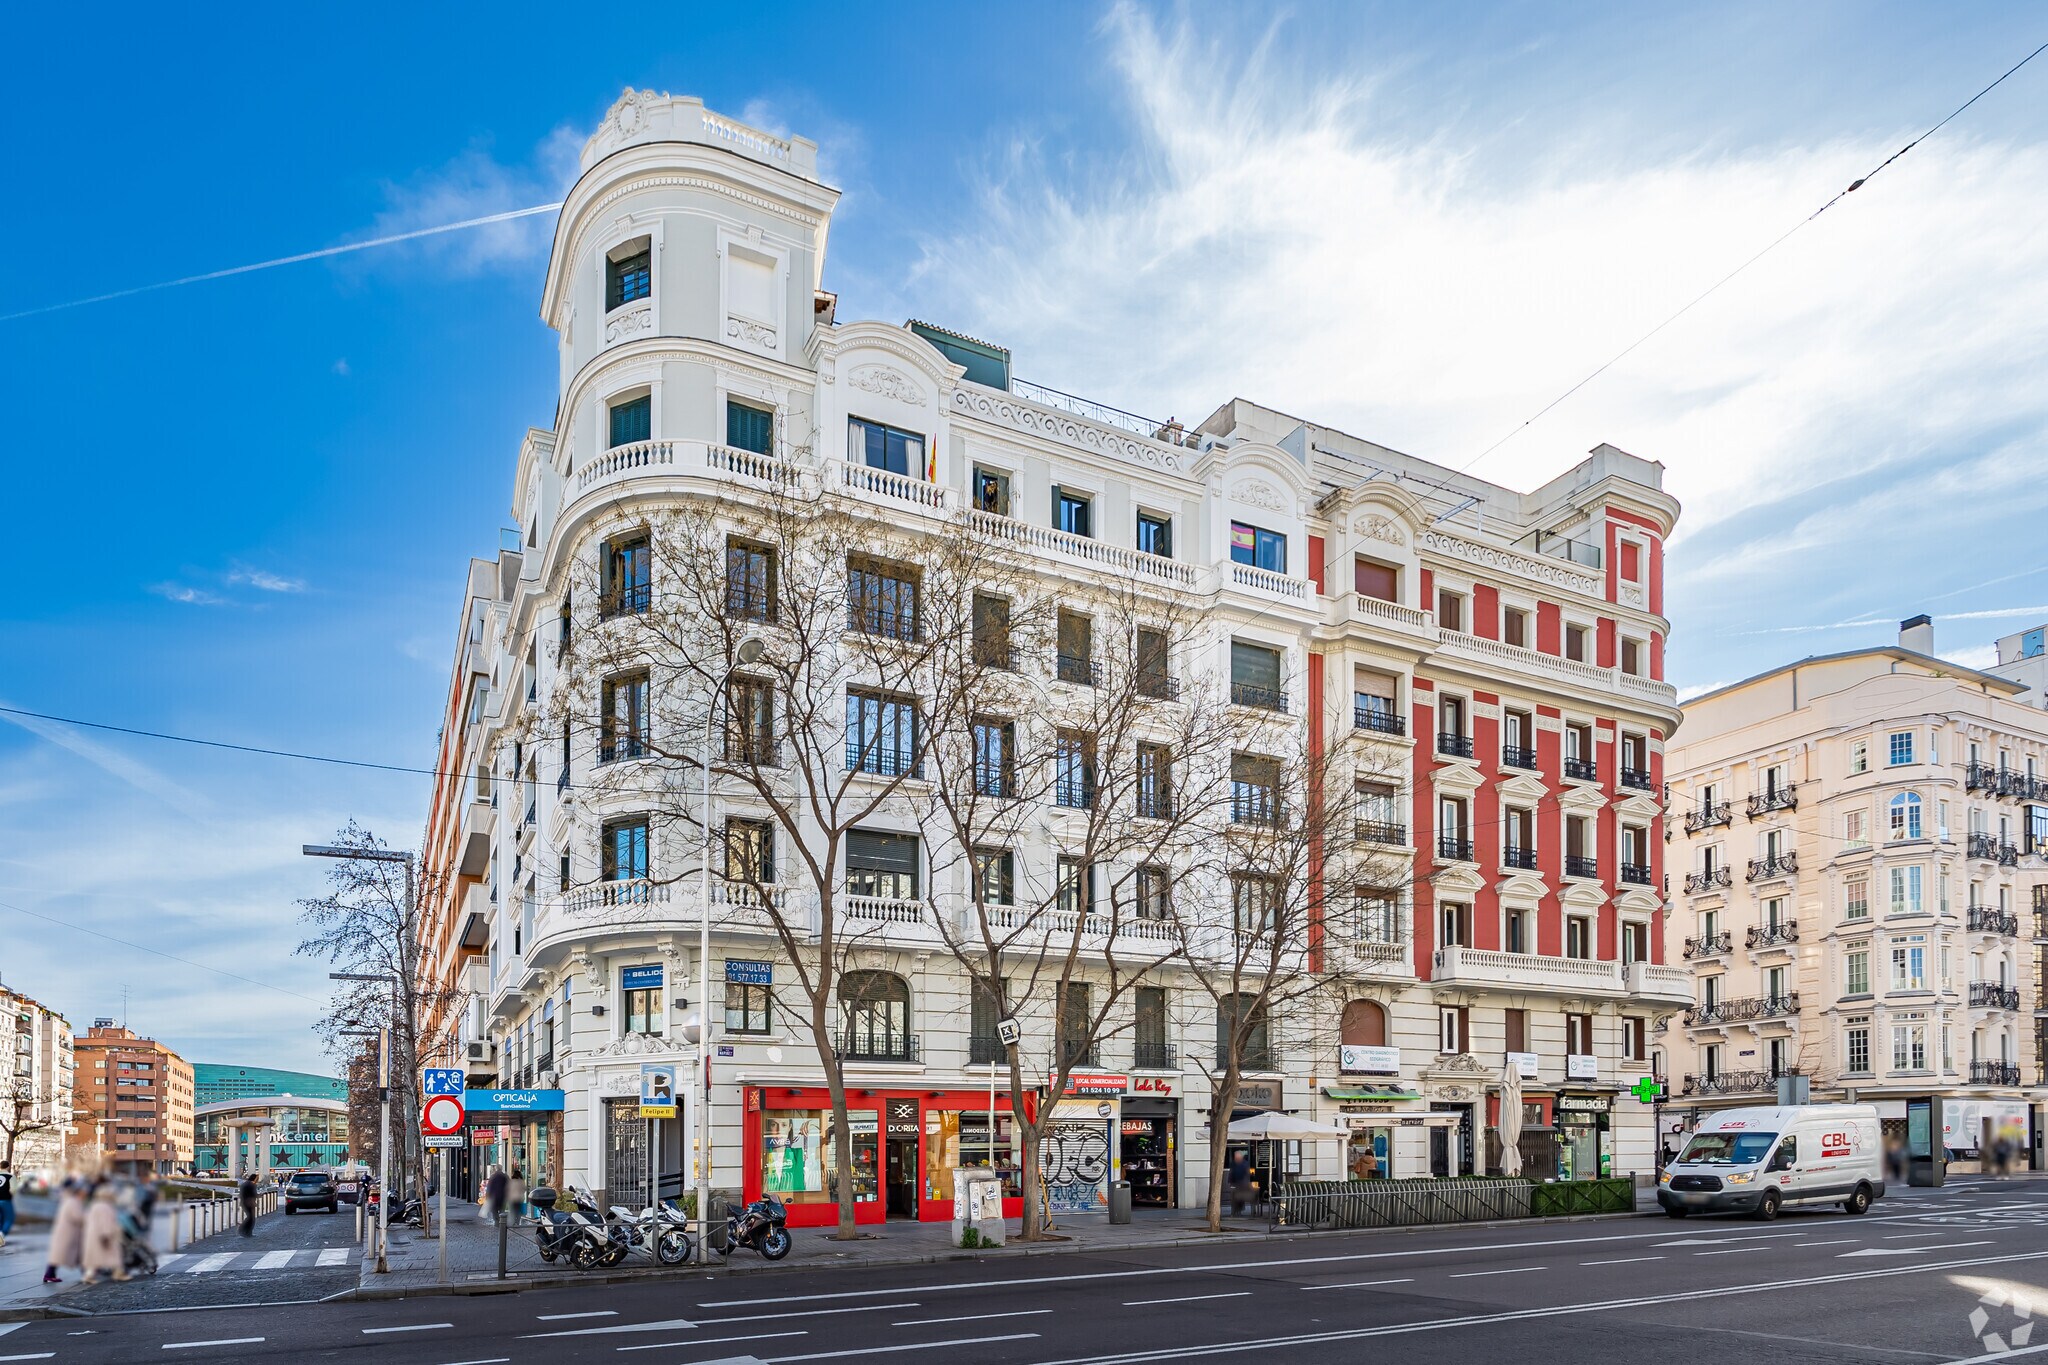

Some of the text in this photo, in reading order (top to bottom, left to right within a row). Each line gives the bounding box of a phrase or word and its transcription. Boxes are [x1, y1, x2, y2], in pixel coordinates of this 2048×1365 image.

[725, 961, 771, 973] CONSULTAS
[738, 974, 749, 982] 577
[750, 975, 758, 983] 17
[759, 976, 768, 984] 33
[1134, 1078, 1171, 1096] Lola Rey
[1559, 1096, 1608, 1110] farmacia
[1821, 1132, 1851, 1148] CBL
